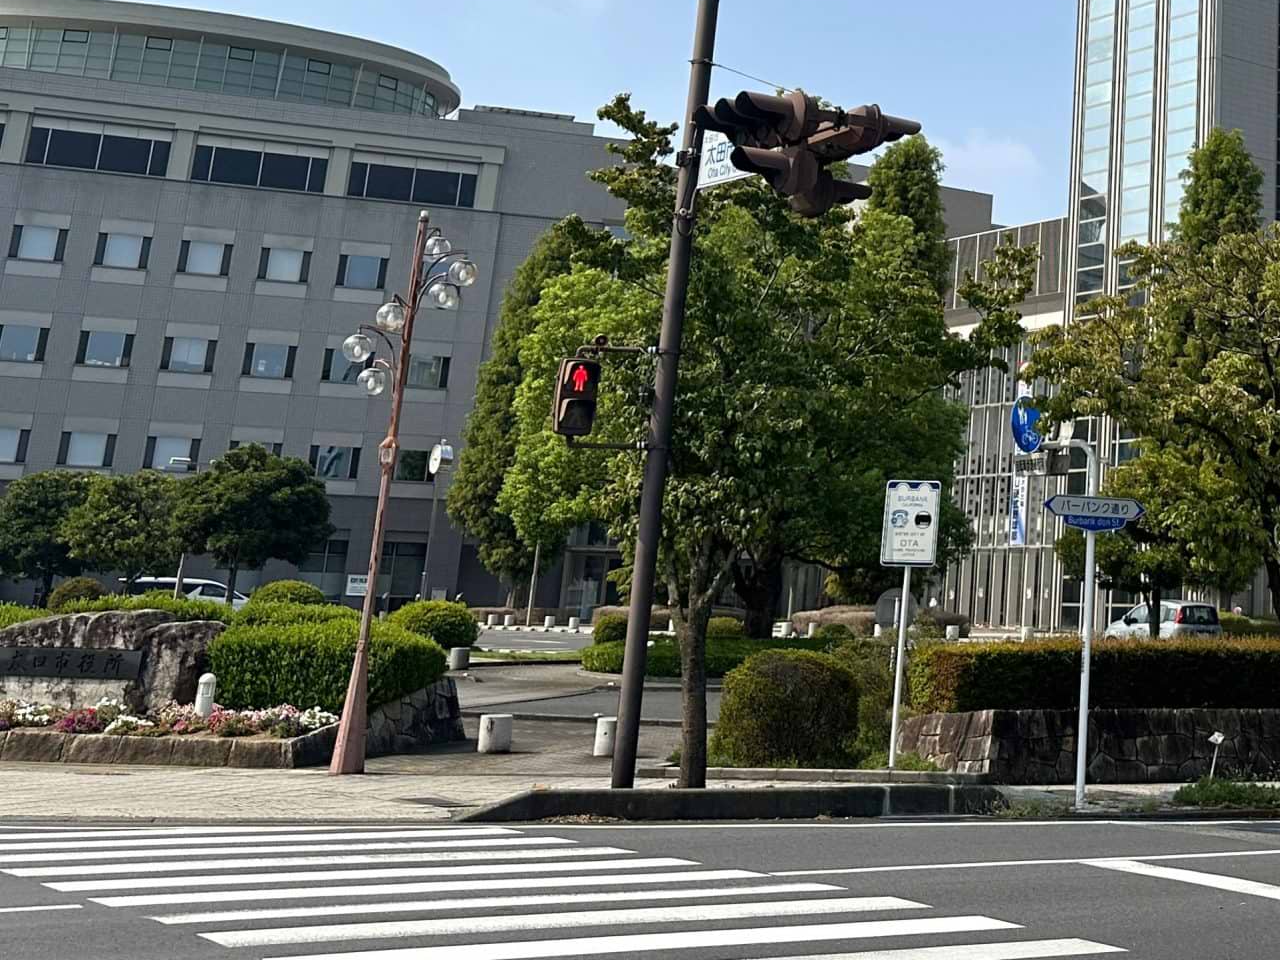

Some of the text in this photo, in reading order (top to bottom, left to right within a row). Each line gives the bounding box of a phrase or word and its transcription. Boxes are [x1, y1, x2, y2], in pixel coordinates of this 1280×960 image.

[1061, 500, 1129, 515] バーバンク通り
[7, 649, 126, 676] 太田市役所
